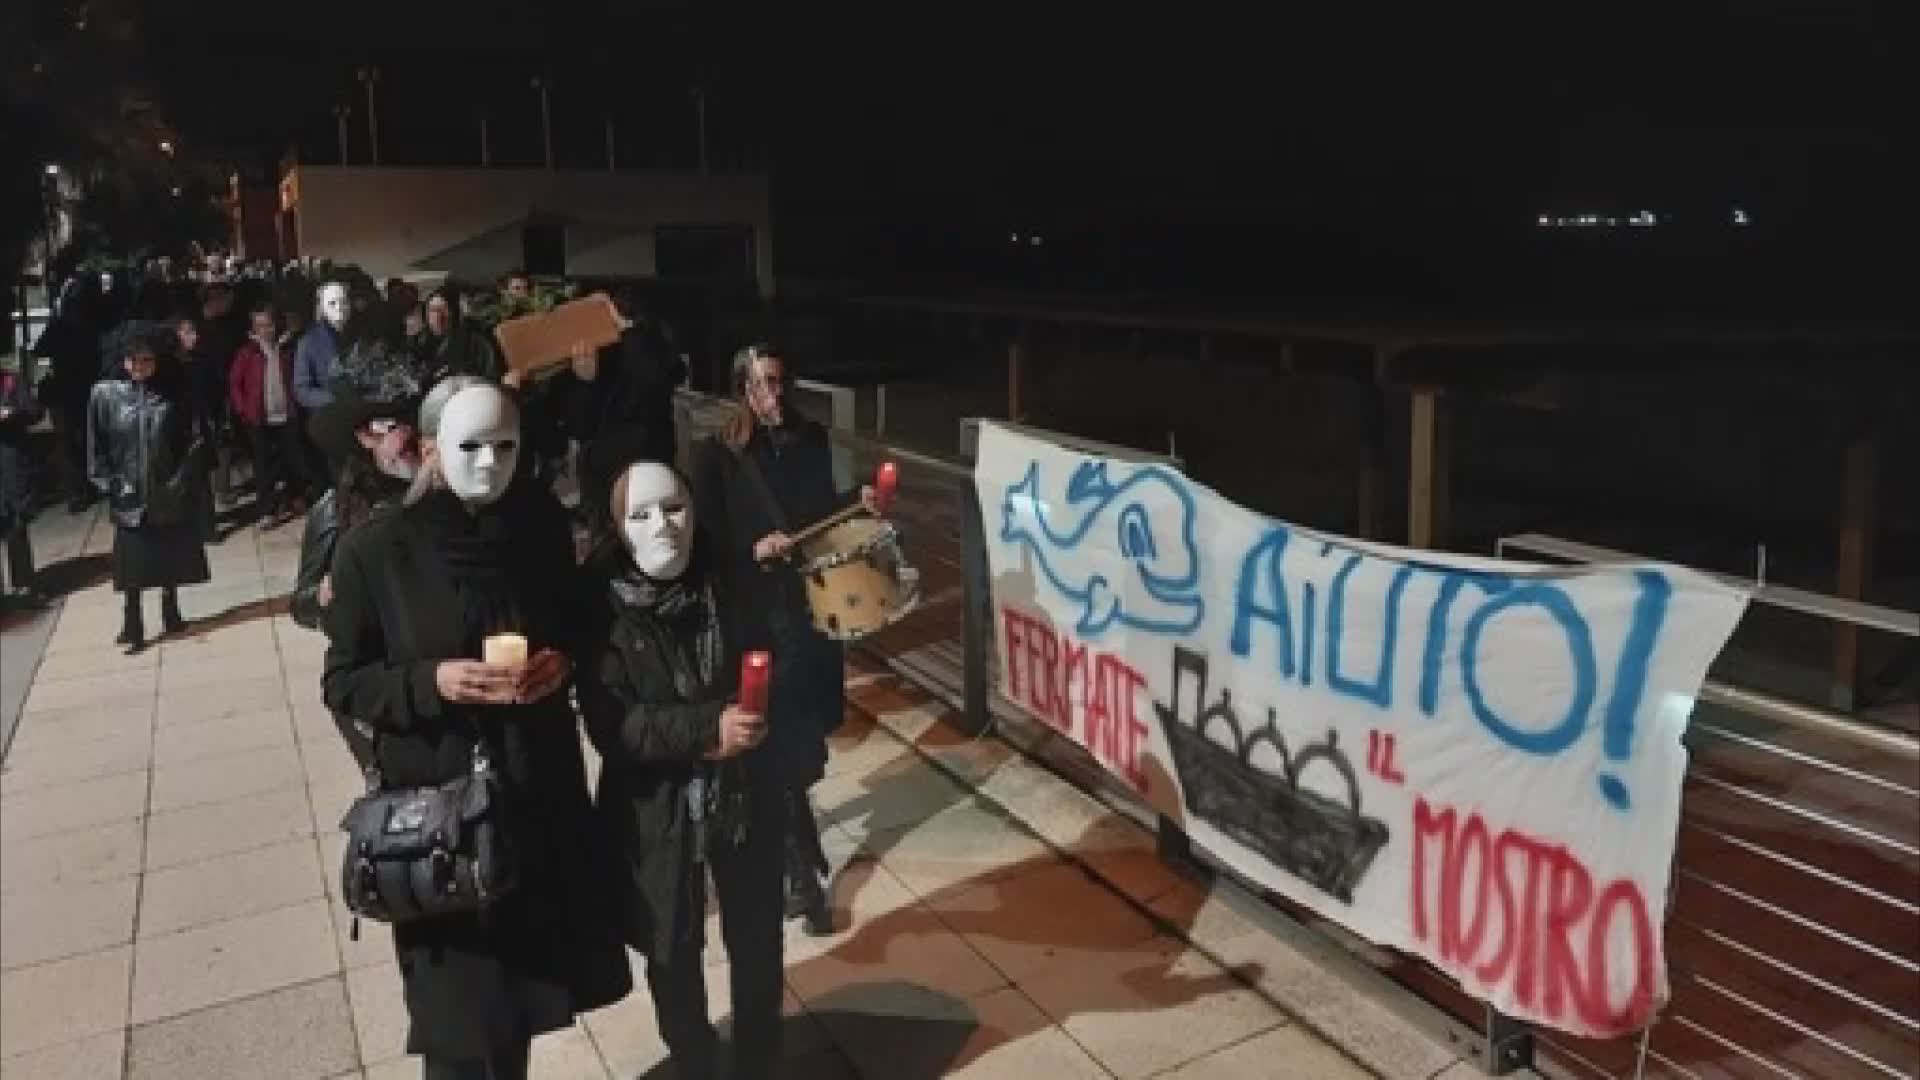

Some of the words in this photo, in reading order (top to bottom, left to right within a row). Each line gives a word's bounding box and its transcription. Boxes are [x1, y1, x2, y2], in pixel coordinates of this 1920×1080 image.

[1003, 608, 1150, 794] FERMATE
[1368, 730, 1405, 783] IL
[1412, 799, 1654, 1036] MOSTRO
